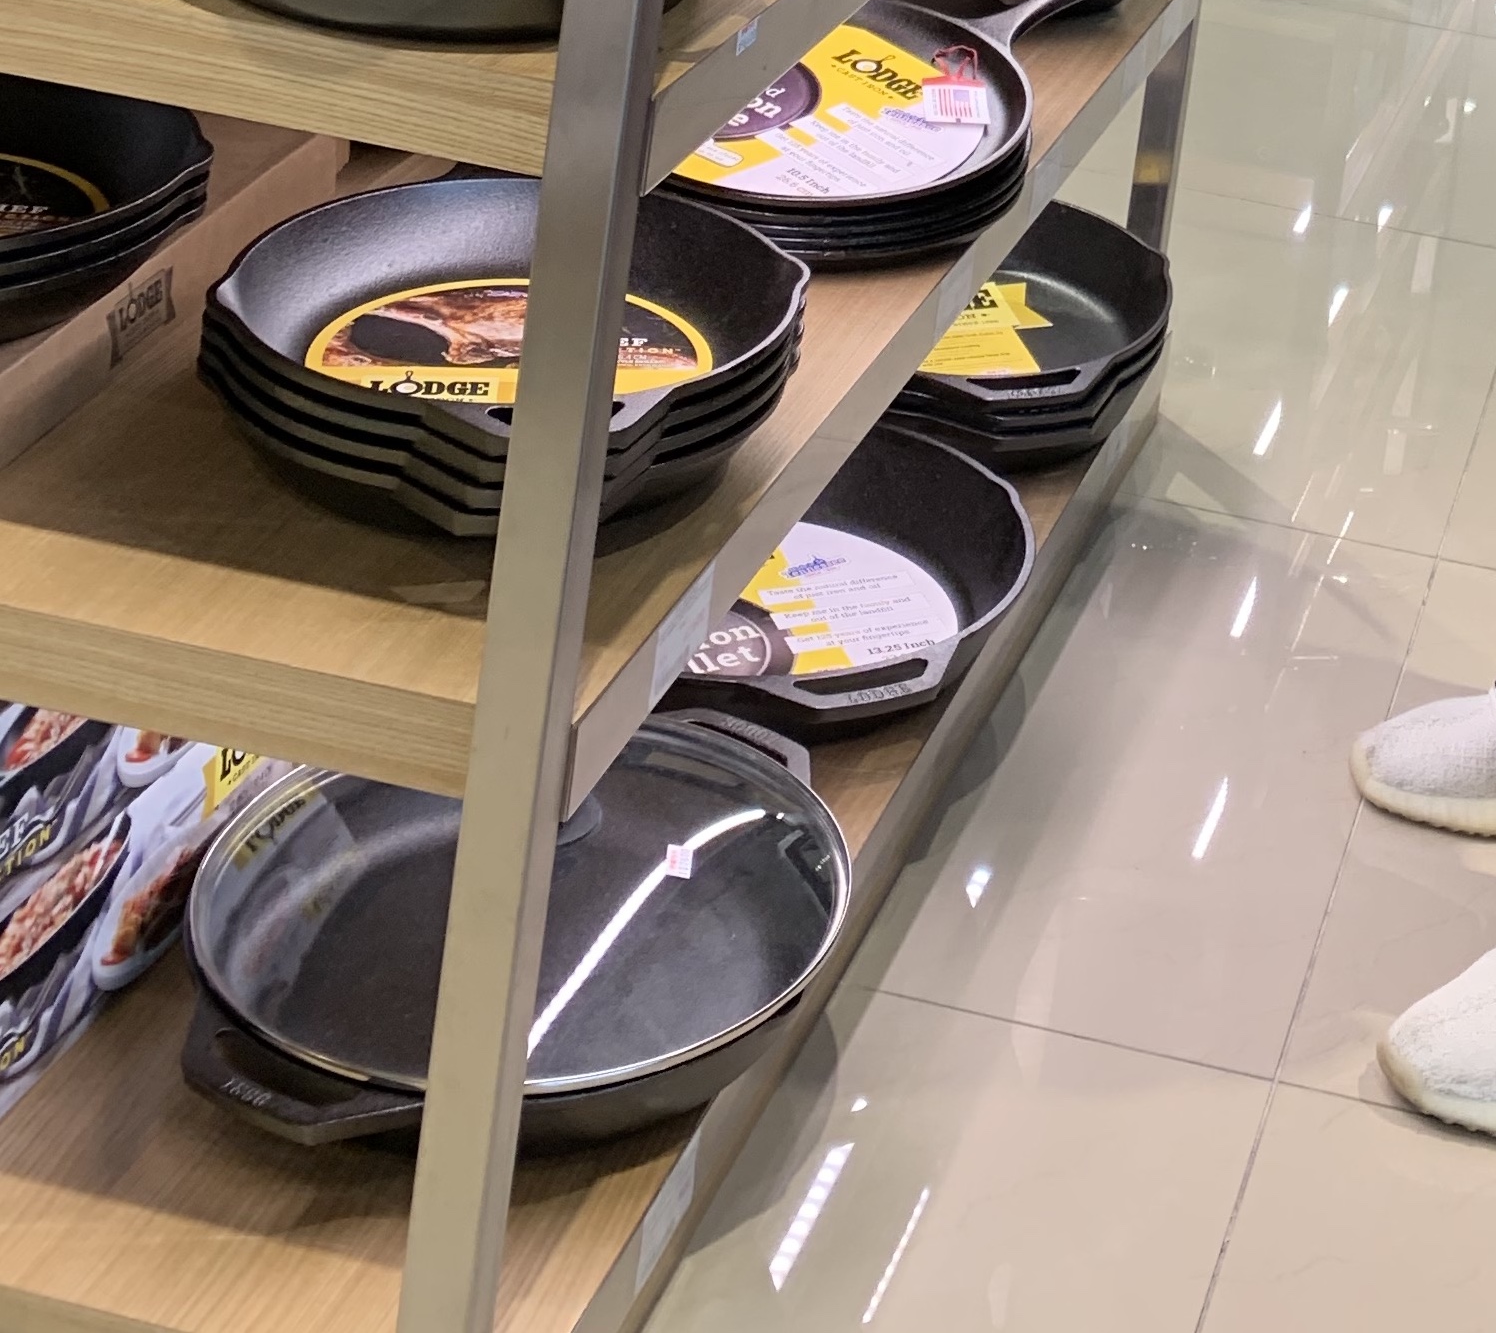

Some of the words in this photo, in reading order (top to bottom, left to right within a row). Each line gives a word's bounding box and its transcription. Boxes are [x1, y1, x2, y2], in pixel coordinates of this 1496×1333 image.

[831, 49, 922, 100] LODGE
[118, 278, 163, 331] LODGE
[369, 375, 490, 396] LODGE
